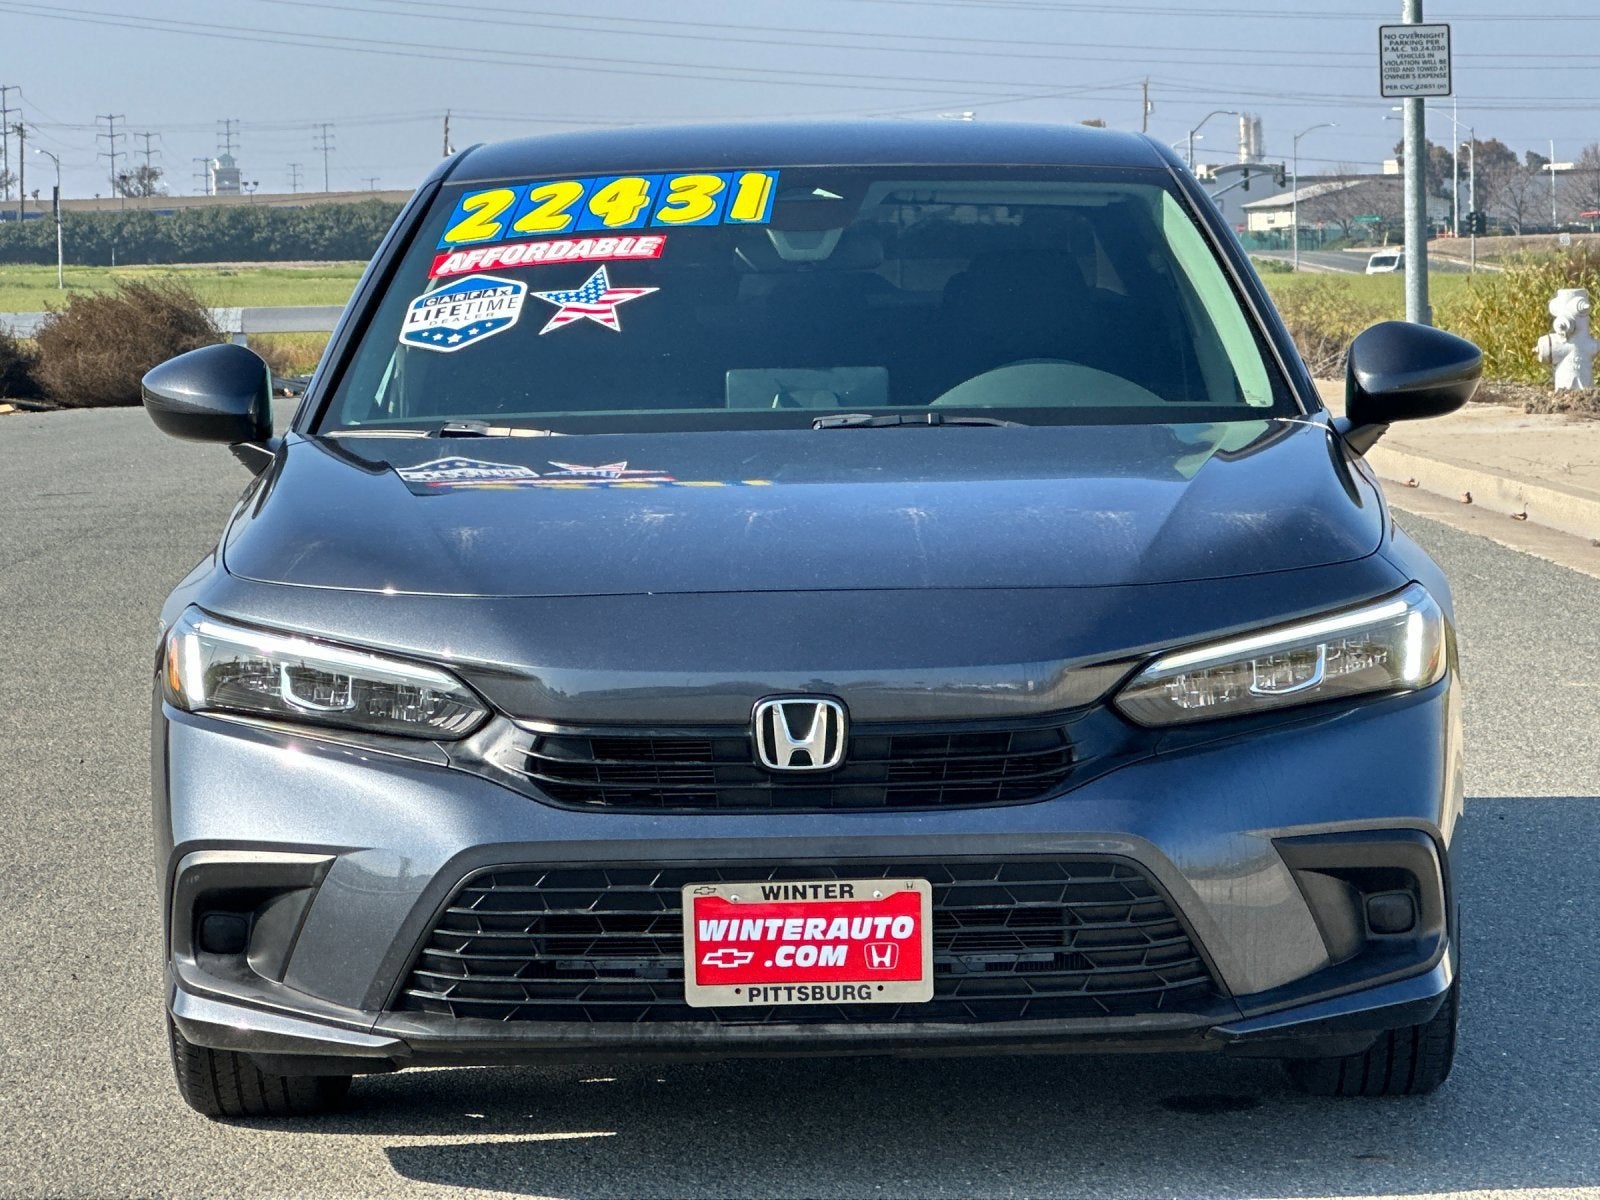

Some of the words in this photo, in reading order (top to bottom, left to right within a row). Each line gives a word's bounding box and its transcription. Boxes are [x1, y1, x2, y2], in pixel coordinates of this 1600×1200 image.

[444, 172, 773, 243] 22431
[436, 236, 663, 276] AFFORDABLE
[424, 287, 511, 308] CARFAX
[410, 296, 520, 324] LIFETIME
[430, 312, 495, 326] DEALER
[761, 884, 854, 900] WINTER
[698, 916, 915, 942] WINTERAUTO
[764, 944, 849, 968] .COM
[748, 984, 872, 1002] PITTSBURG
